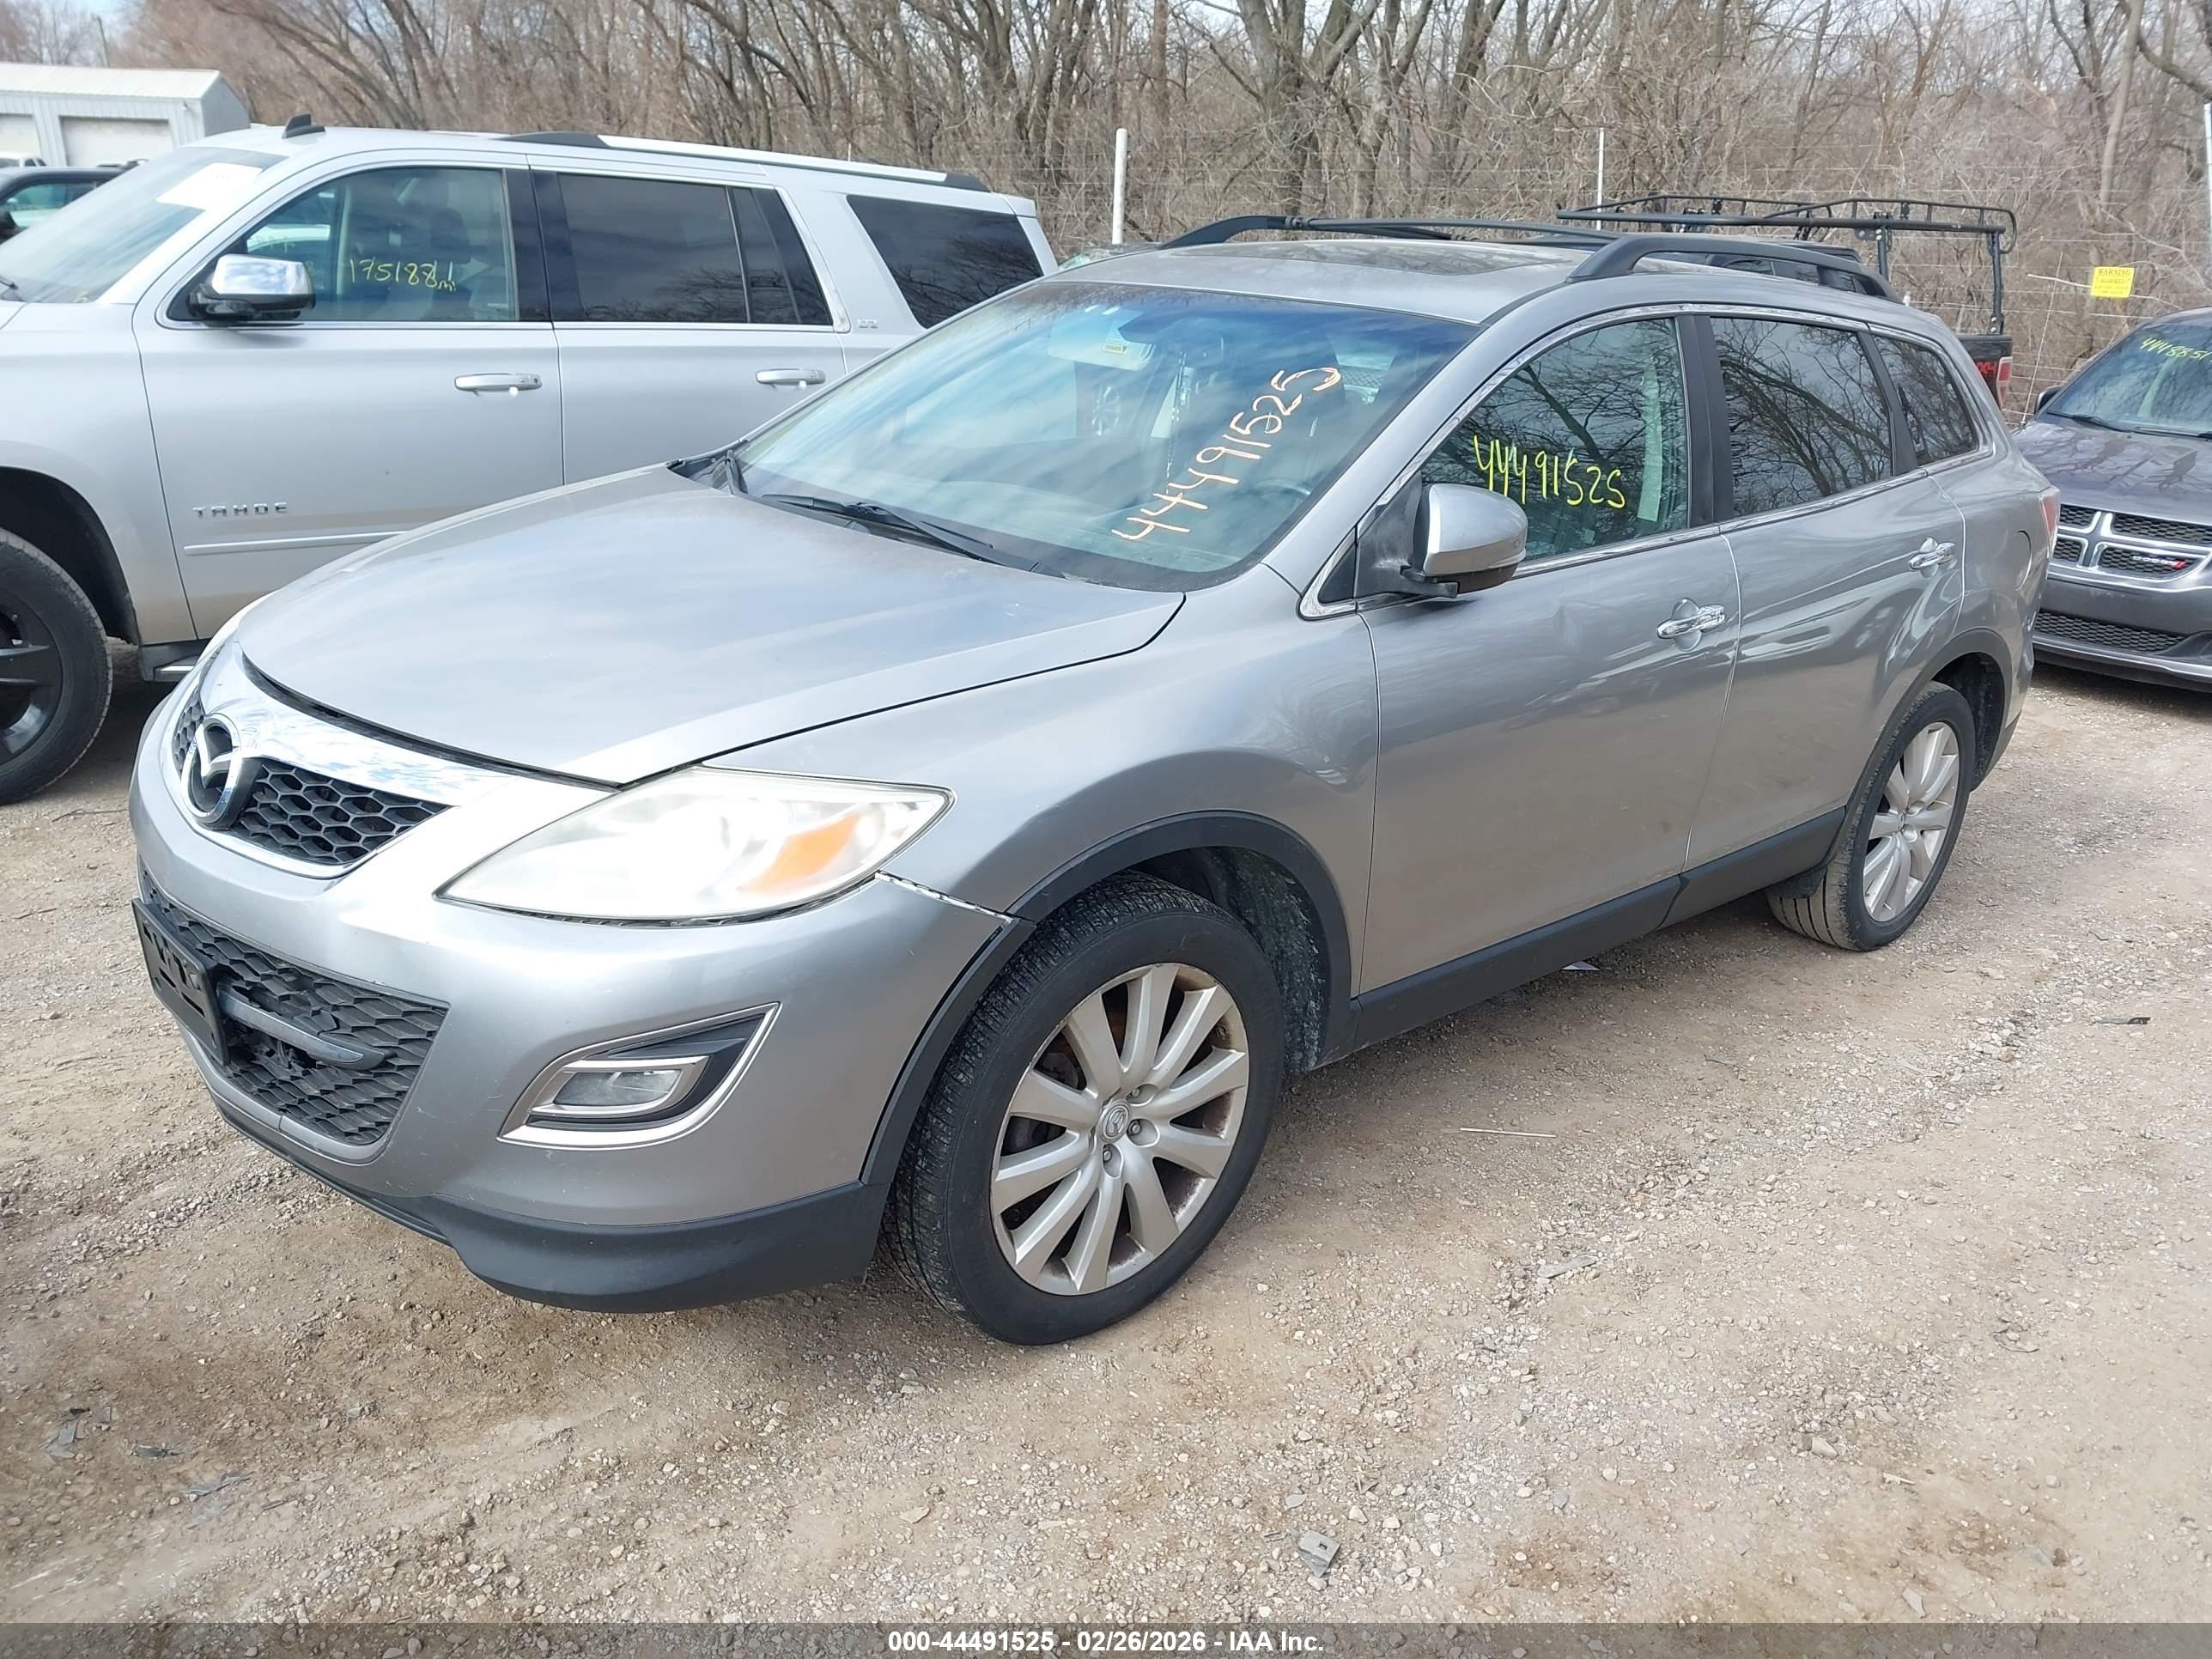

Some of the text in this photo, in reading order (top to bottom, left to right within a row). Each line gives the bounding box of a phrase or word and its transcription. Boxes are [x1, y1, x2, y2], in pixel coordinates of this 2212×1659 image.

[1111, 367, 1341, 540] 44491525
[1474, 434, 1626, 508] 44491525
[192, 502, 288, 518] TAHOE
